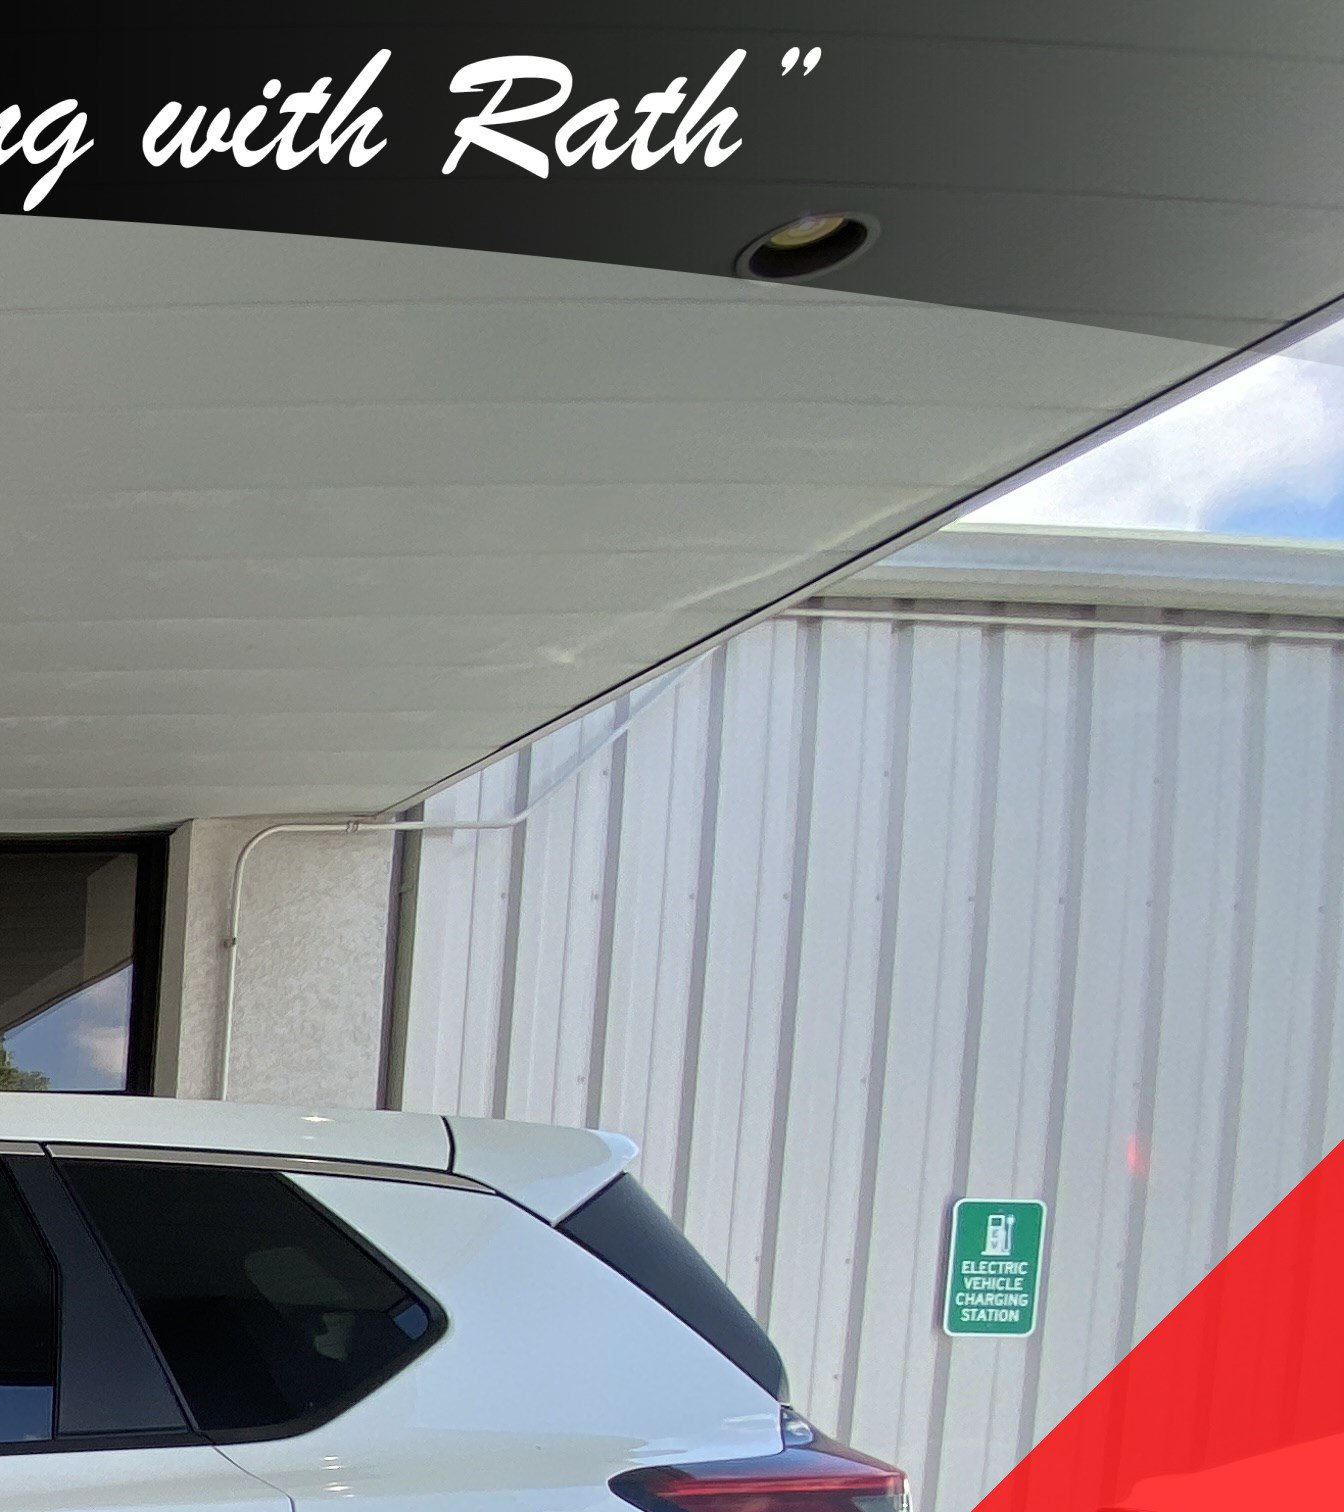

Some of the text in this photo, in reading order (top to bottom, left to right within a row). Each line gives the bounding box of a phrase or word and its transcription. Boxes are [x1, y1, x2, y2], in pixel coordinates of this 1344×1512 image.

[961, 1260, 1028, 1274] ELECTRIC
[963, 1276, 1023, 1291] VEHICLE
[955, 1292, 1028, 1307] CHARGING
[960, 1308, 1019, 1322] STATION
